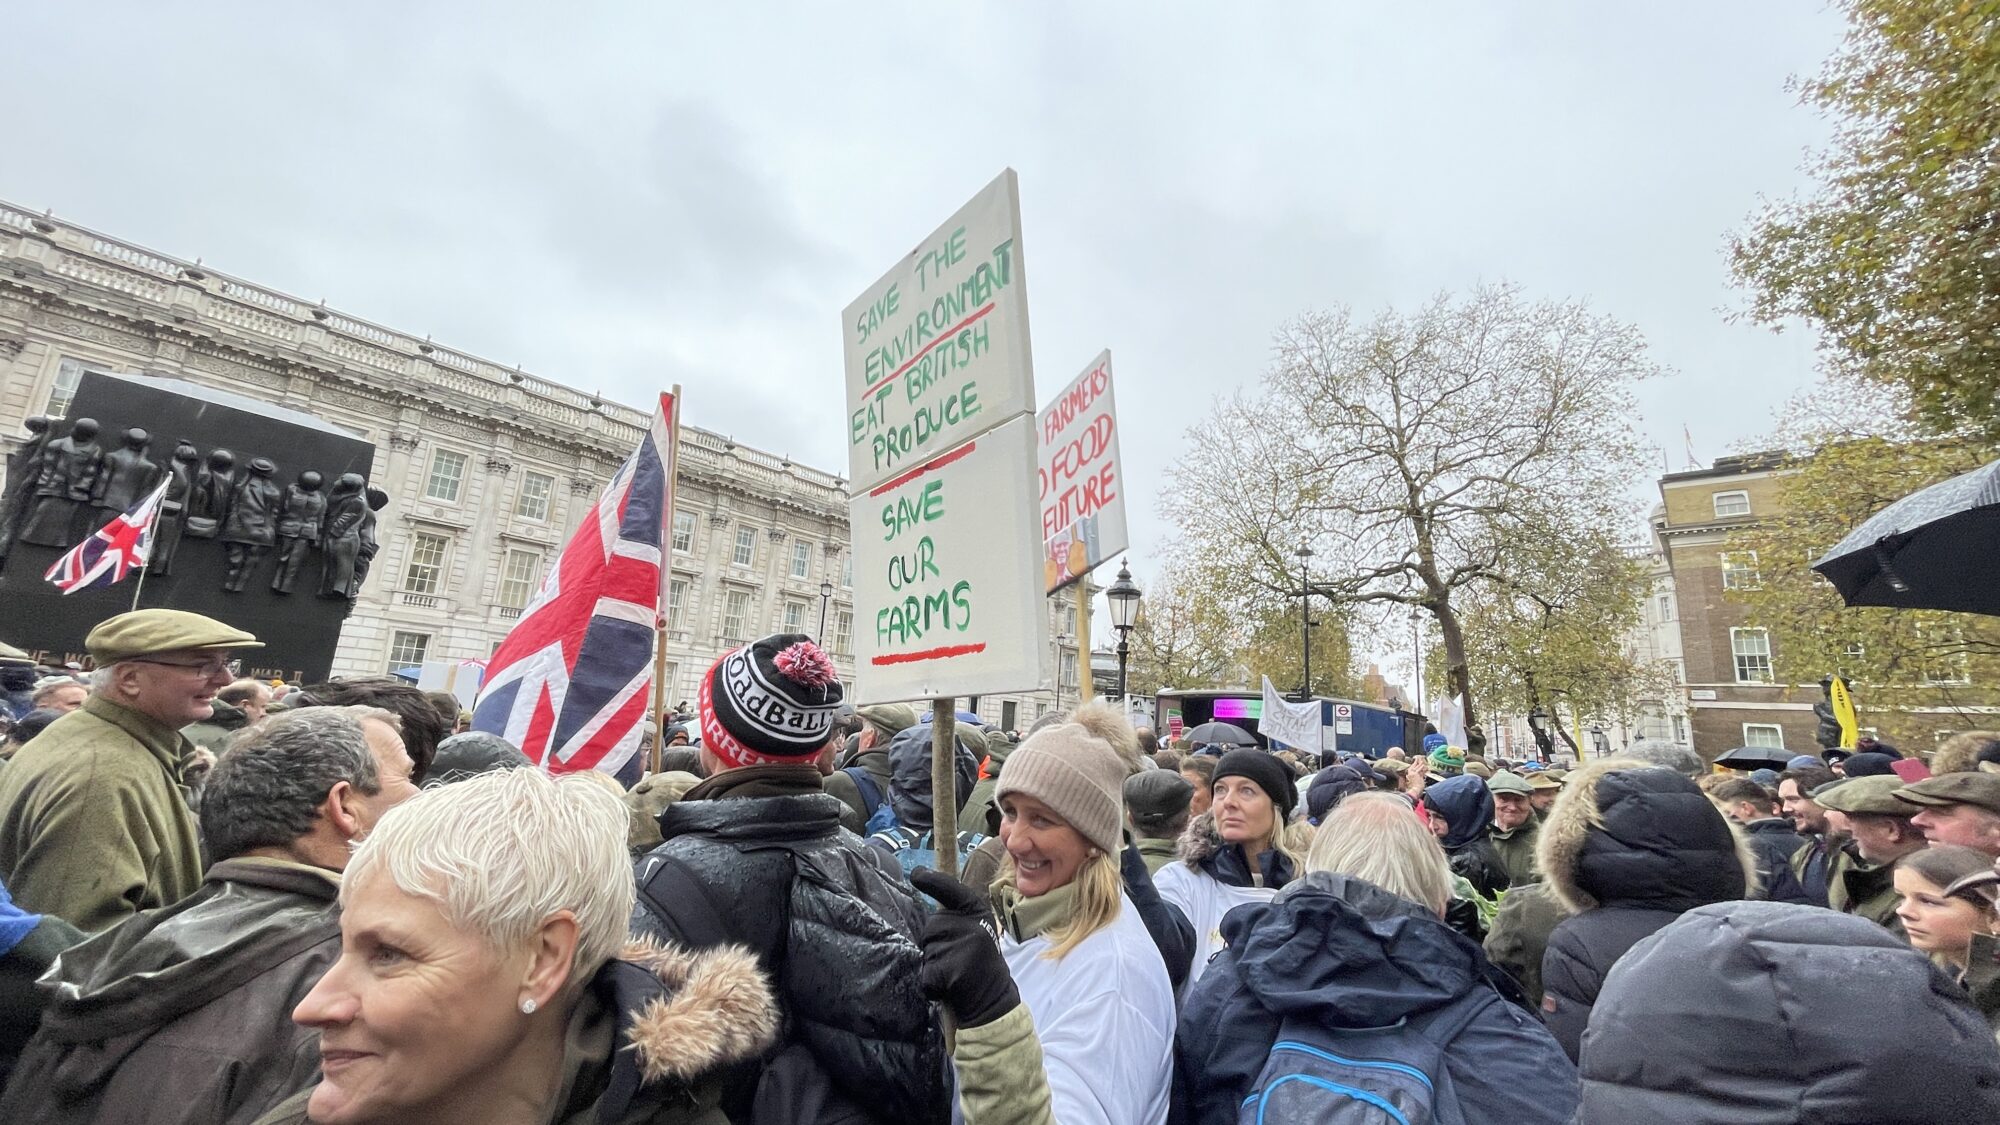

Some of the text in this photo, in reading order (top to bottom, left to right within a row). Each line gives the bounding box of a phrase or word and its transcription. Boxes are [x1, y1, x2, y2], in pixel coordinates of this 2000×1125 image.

[857, 225, 967, 345] SAVE THE
[865, 238, 1013, 386] ENVIRONMENT
[851, 319, 990, 446] EAT BRITISH
[1045, 361, 1109, 447] FARMERS
[871, 381, 983, 472] PRODUCE
[1051, 413, 1114, 493] FOOD
[882, 479, 945, 542] SAVE
[1043, 460, 1116, 542] FUTURE
[888, 535, 940, 592] OUR
[877, 580, 972, 648] FARMS
